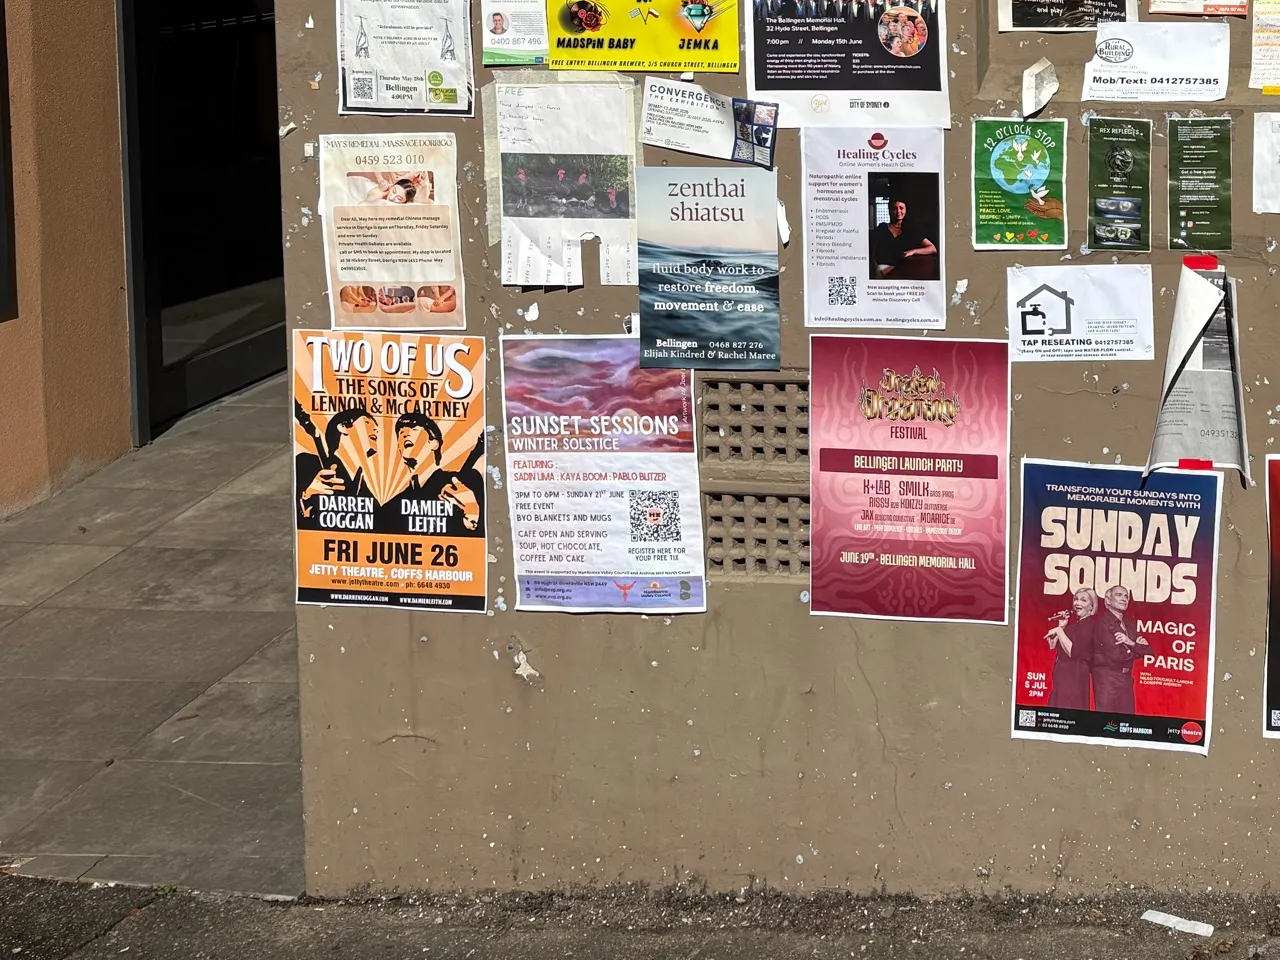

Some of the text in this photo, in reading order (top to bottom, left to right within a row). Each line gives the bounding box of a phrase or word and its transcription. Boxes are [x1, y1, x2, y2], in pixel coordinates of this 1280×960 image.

[1092, 76, 1219, 86] Mob/Text: 0412757385
[650, 84, 726, 108] CONVERGENCE
[355, 154, 424, 165] 0459 523 010
[837, 149, 917, 161] Healing Cycles
[668, 178, 746, 197] zenthai
[670, 202, 744, 222] shiatsu
[306, 335, 474, 400] TWO OF US
[511, 415, 679, 436] SUNSET SESSIONS
[890, 426, 927, 440] FESTIVAL
[513, 438, 620, 451] WINTER SOLSTICE
[854, 455, 963, 473] BELLINGEN LAUNCH PARTY
[1040, 506, 1201, 559] SUNDAY
[323, 538, 459, 567] FRI JUNE 26
[1043, 553, 1198, 605] SOUNDS
[1136, 619, 1196, 637] MAGIC
[1172, 640, 1195, 654] OF
[1143, 654, 1194, 672] PARIS
